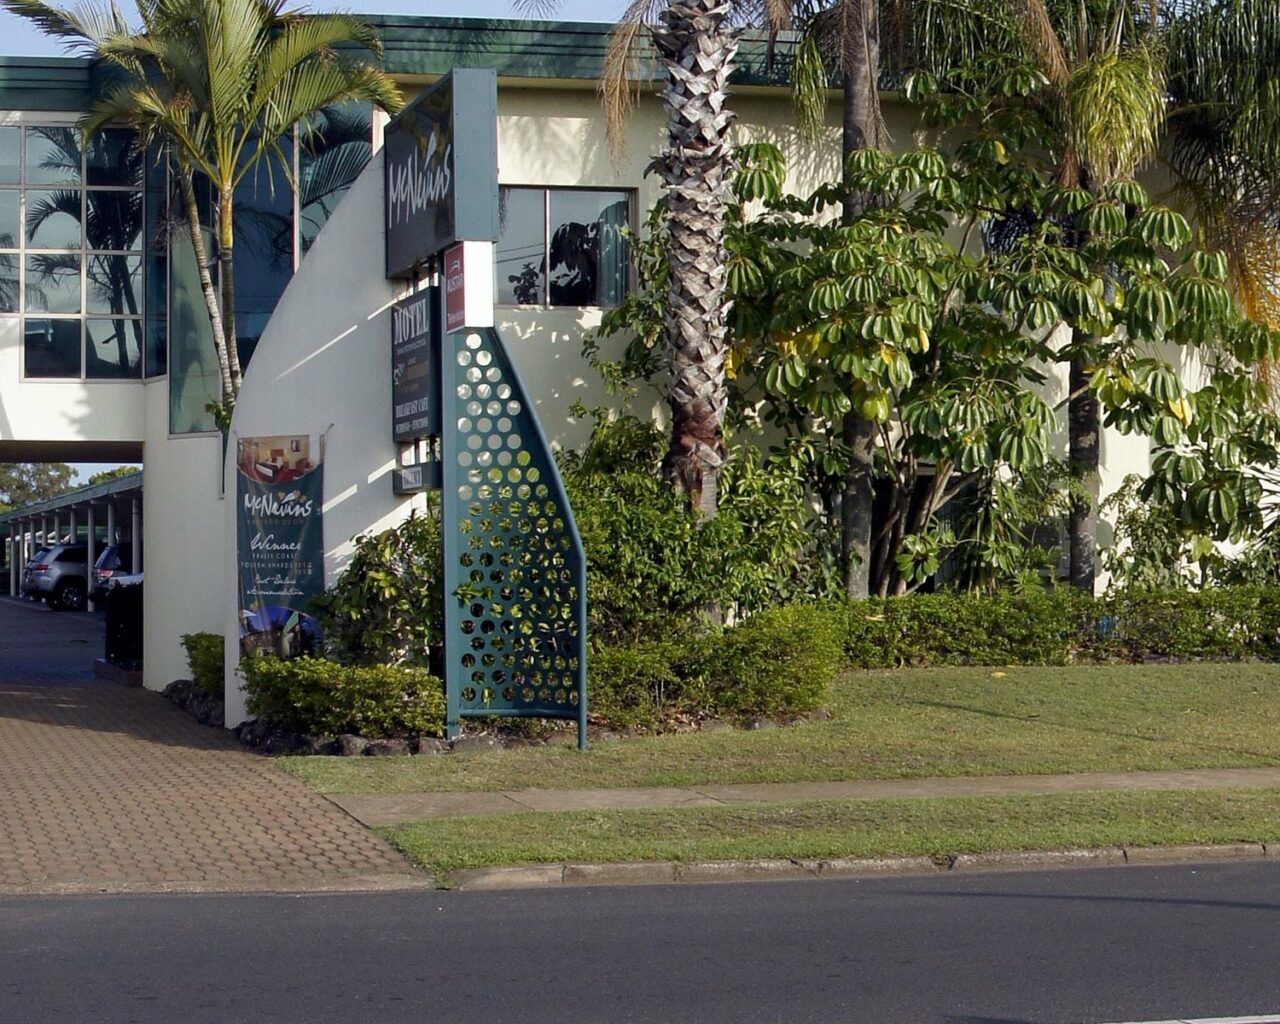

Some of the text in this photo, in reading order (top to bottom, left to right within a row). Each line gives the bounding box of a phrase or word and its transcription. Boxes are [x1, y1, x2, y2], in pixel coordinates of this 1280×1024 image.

[388, 131, 451, 229] McNevins
[393, 298, 429, 345] MOTEL
[244, 490, 313, 517] McNevins
[250, 532, 302, 550] Winner
